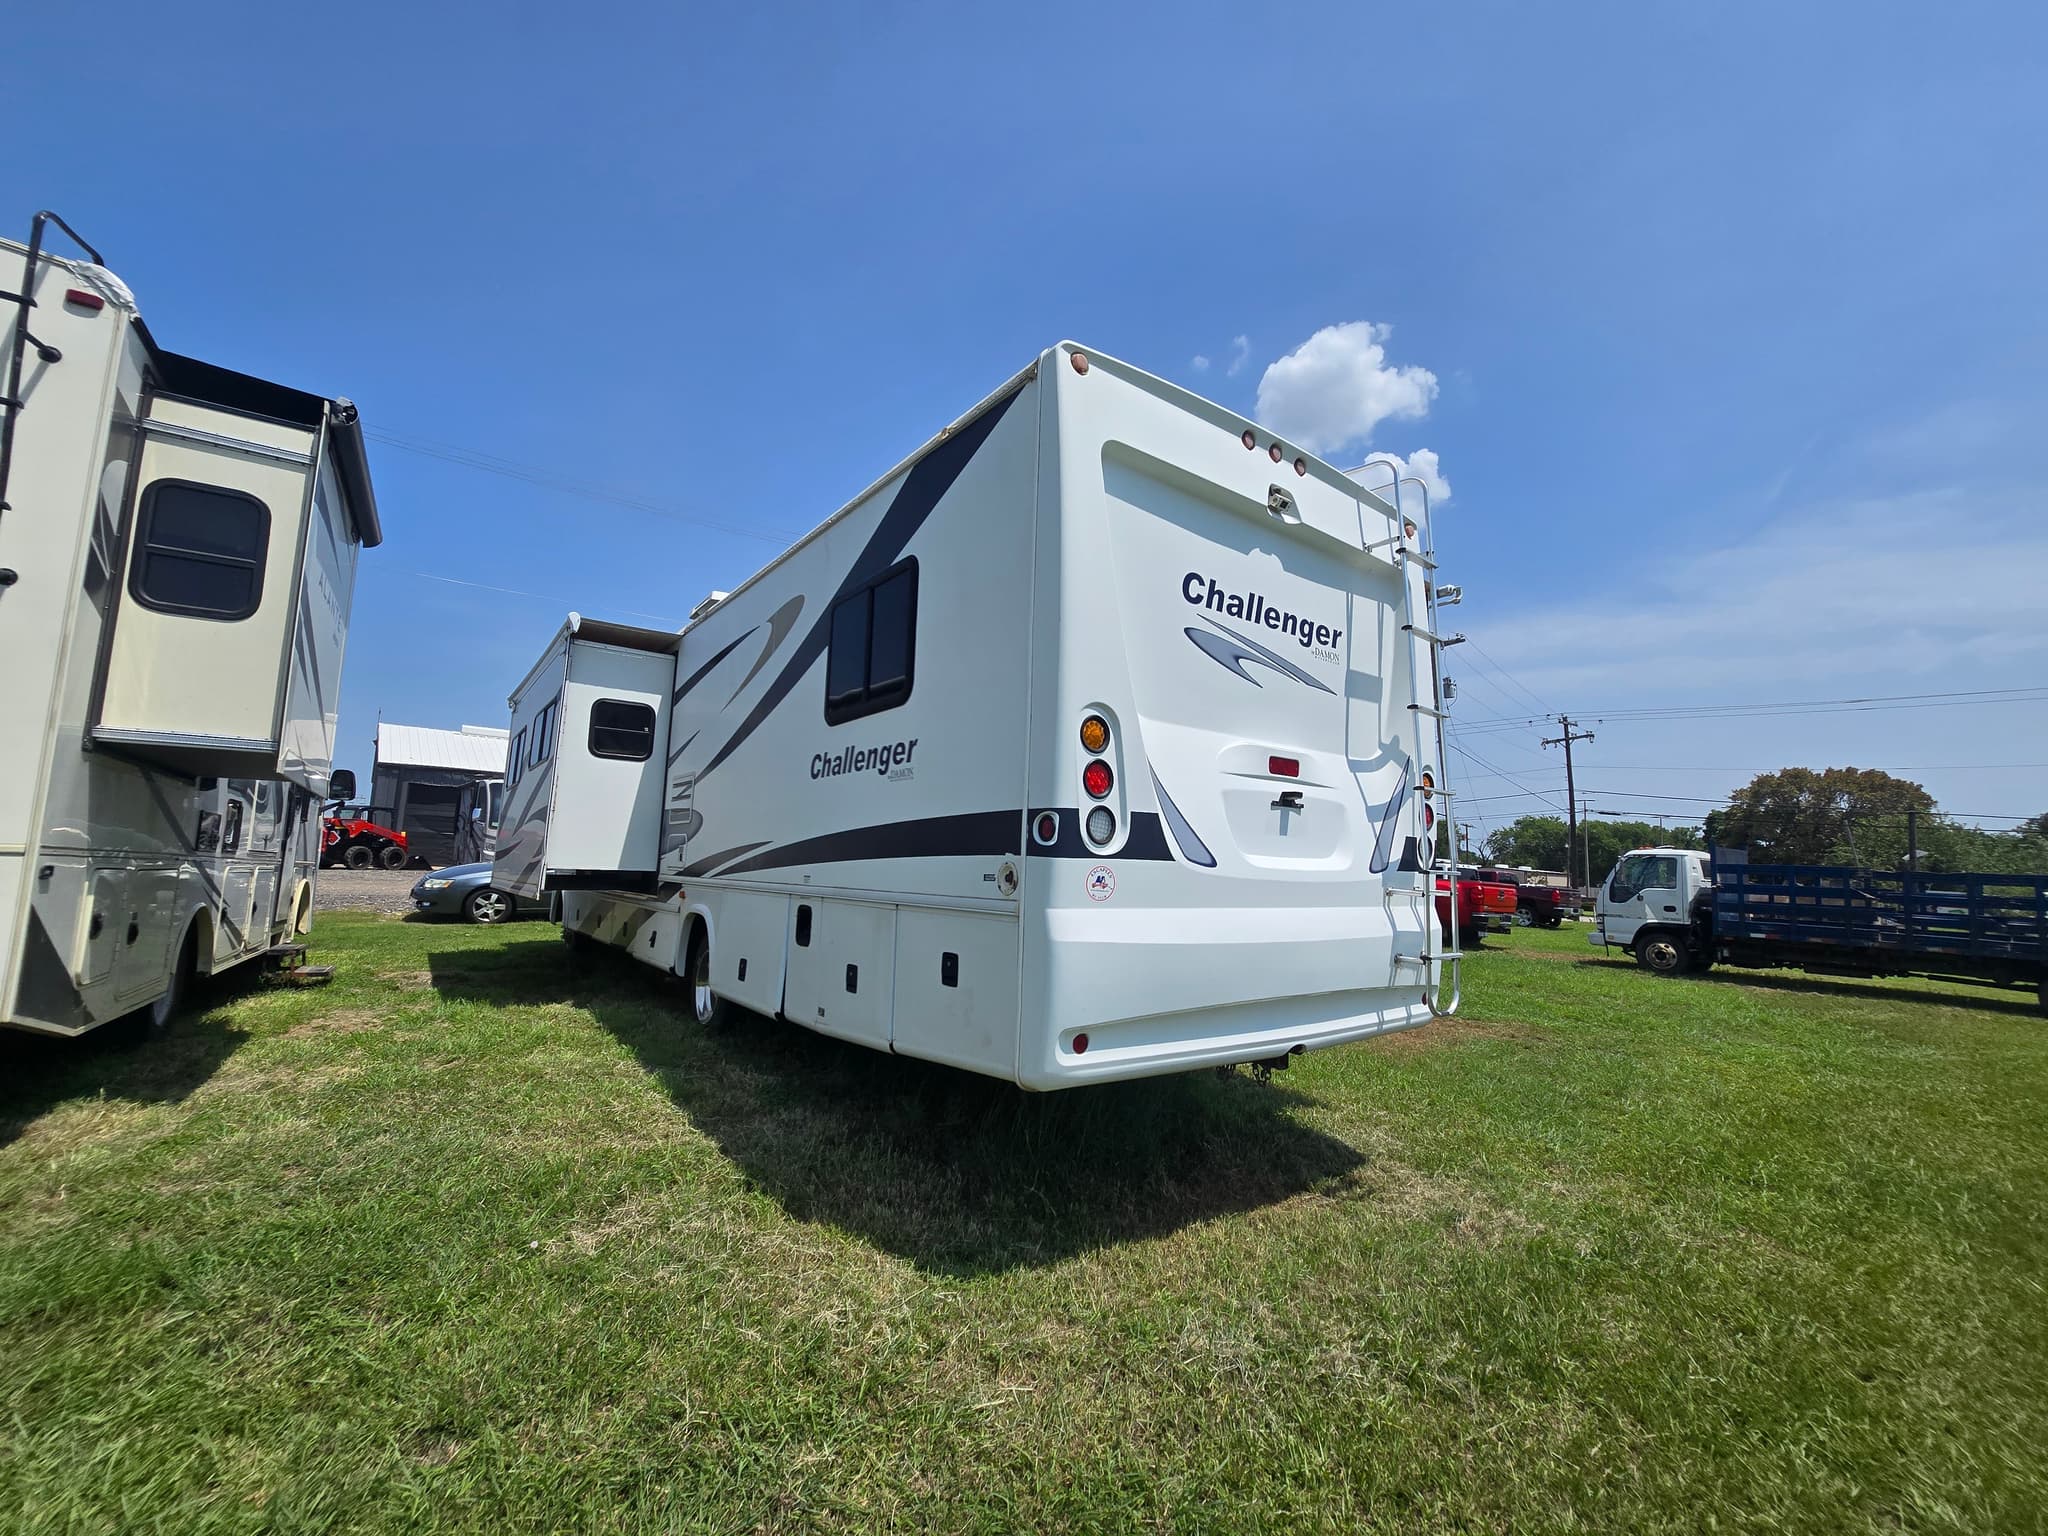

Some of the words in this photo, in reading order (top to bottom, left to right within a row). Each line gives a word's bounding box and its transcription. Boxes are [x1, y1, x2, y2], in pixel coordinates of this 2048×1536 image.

[1182, 572, 1342, 649] Challenger
[1314, 647, 1340, 662] DAMON
[810, 738, 918, 780] Challenger
